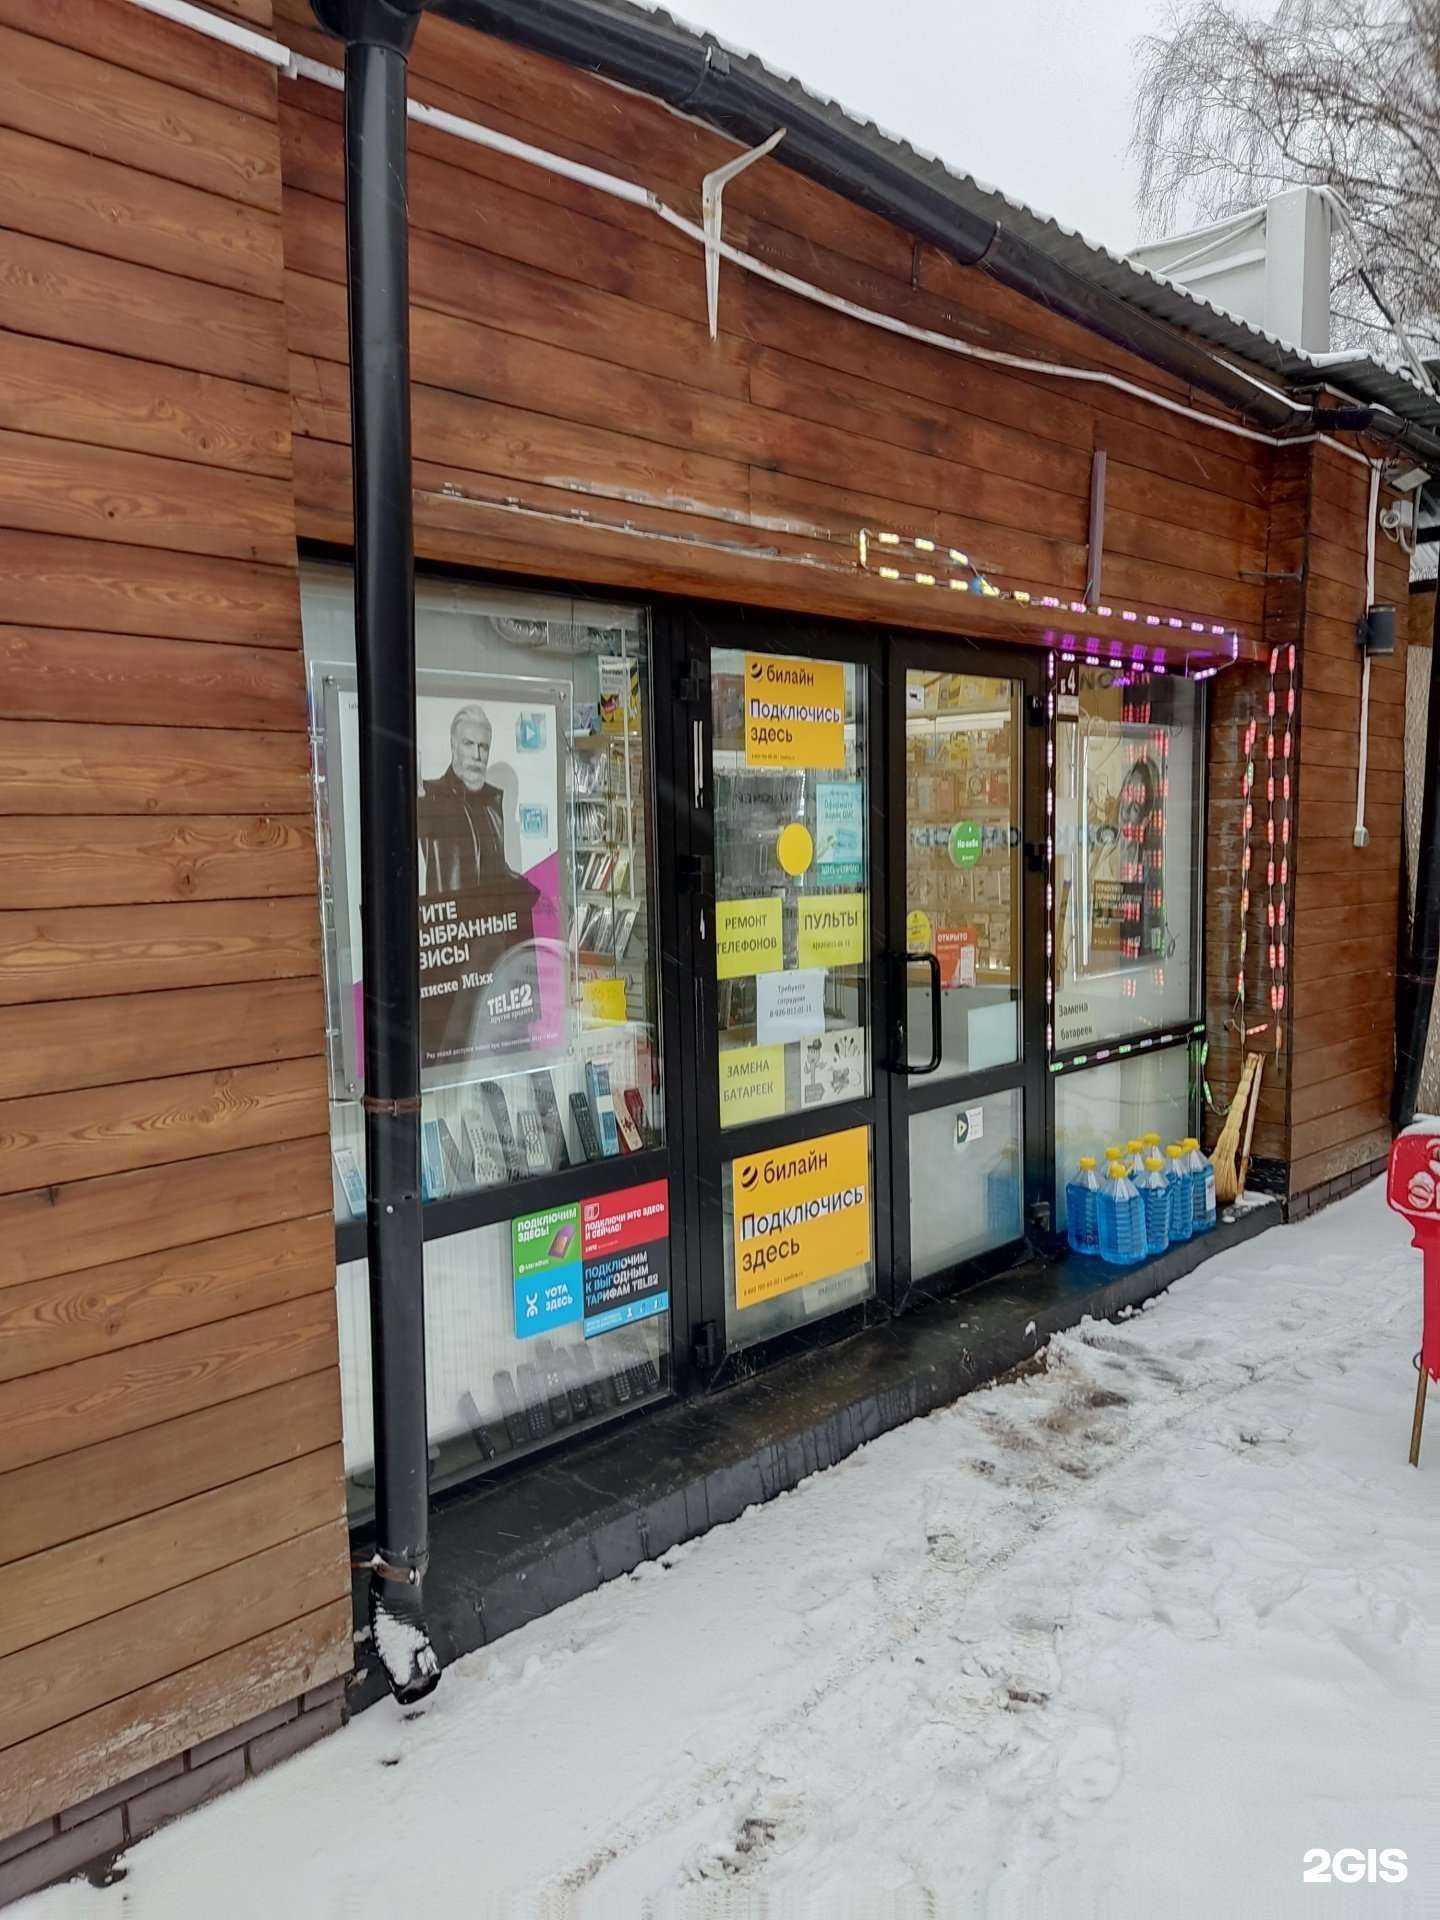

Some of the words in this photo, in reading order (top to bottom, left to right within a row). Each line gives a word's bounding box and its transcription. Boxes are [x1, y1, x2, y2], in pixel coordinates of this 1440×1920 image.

[767, 664, 815, 687] билайн
[750, 698, 840, 723] Подключись
[750, 726, 793, 745] здесь
[419, 901, 458, 925] ИТЕ
[725, 914, 768, 930] РЕМОНТ
[804, 911, 858, 931] ПУЛЬТЫ
[716, 937, 777, 956] ТЕЛЕФОНОВ
[937, 932, 968, 943] ОТКРЫТО
[461, 971, 494, 991] Mixx
[487, 984, 533, 1017] TELE2
[1058, 1001, 1089, 1017] Замена
[1060, 1025, 1093, 1041] батареек
[727, 1059, 770, 1079] ЗАМЕНА
[723, 1081, 774, 1102] БАТАРЕЕК
[763, 1150, 829, 1184] билайн
[517, 1207, 577, 1233] ПОДКЛЮЧИМ
[584, 1214, 626, 1231] ПОДКЛЮЧИ
[626, 1209, 642, 1220] МТС
[642, 1203, 665, 1217] ЗДЕСЬ
[741, 1187, 864, 1241] Подключись
[517, 1227, 550, 1243] ЗДЕСЬ!
[584, 1232, 590, 1241] И
[591, 1223, 622, 1239] СЕЙЧАС!
[585, 1251, 648, 1279] ПОДКЛЮЧИМ
[742, 1238, 800, 1274] здесь
[585, 1282, 592, 1293] К
[594, 1263, 649, 1290] ВЫГОДНЫМ
[544, 1283, 569, 1298] YOTA
[585, 1284, 631, 1307] ТАРИФАМ
[631, 1273, 659, 1292] TELE2
[545, 1296, 574, 1313] ЗДЕСЬ
